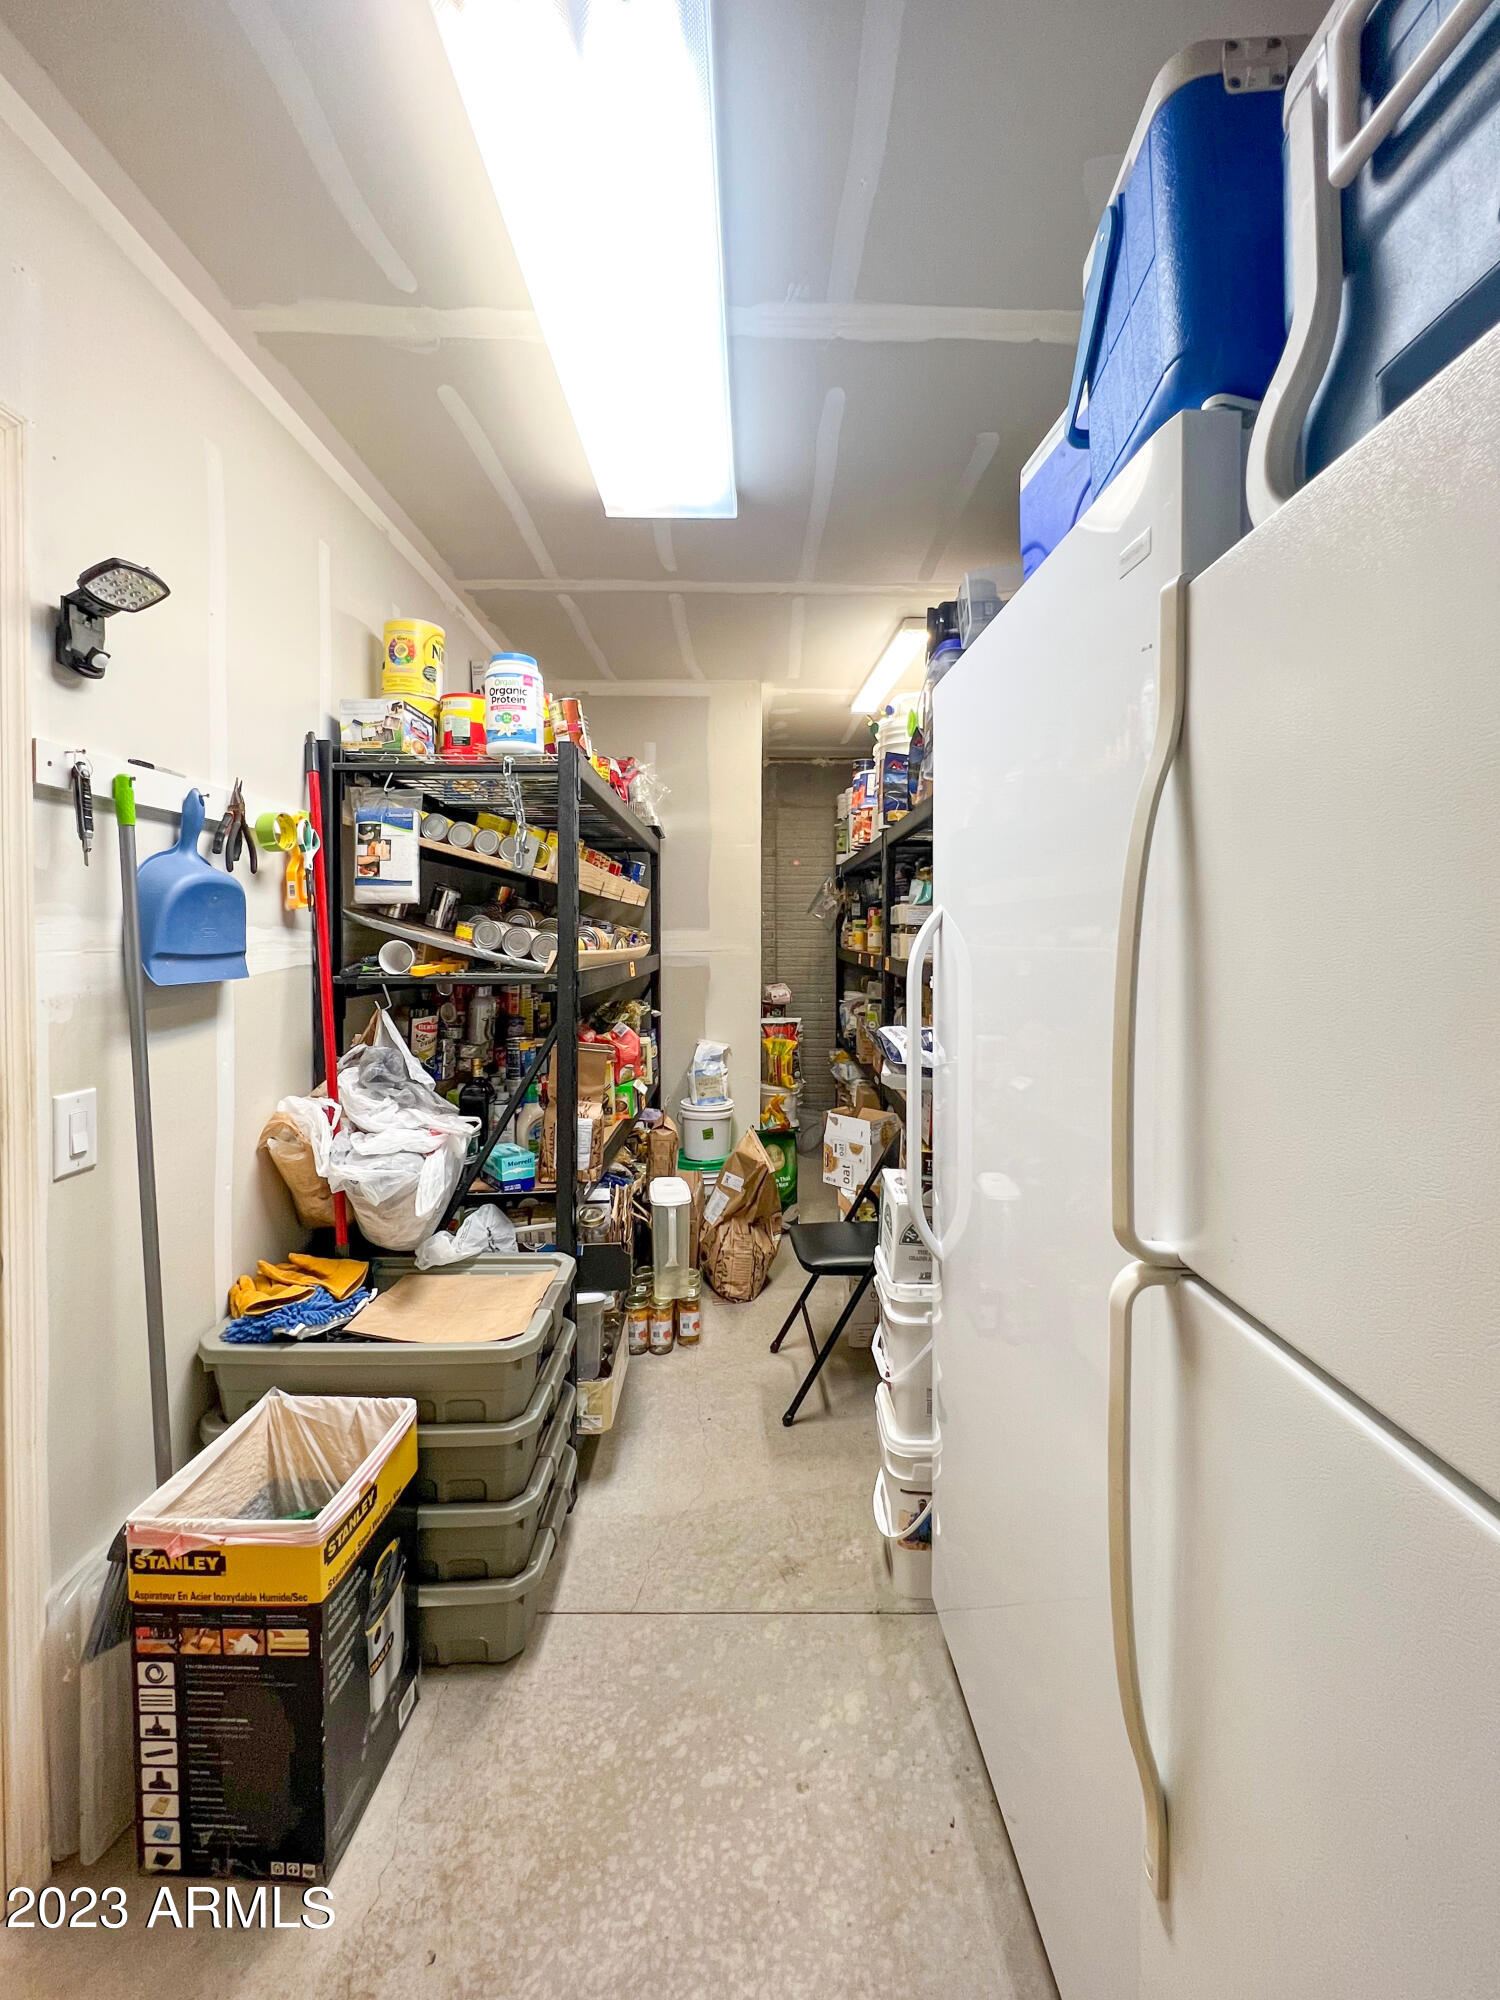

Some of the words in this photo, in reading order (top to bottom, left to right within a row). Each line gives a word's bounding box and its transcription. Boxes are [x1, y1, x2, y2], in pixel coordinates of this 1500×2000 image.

[494, 678, 519, 687] Orgain
[489, 687, 528, 696] Organic
[491, 695, 526, 705] Protein
[842, 1165, 851, 1185] oat
[327, 1489, 375, 1558] STANLEY
[134, 1555, 220, 1571] STANLEY
[134, 1590, 176, 1601] Aspirateur
[177, 1591, 188, 1601] En
[190, 1591, 211, 1601] Acier
[213, 1591, 257, 1603] Inoxydable
[259, 1592, 308, 1602] Humide/Sec
